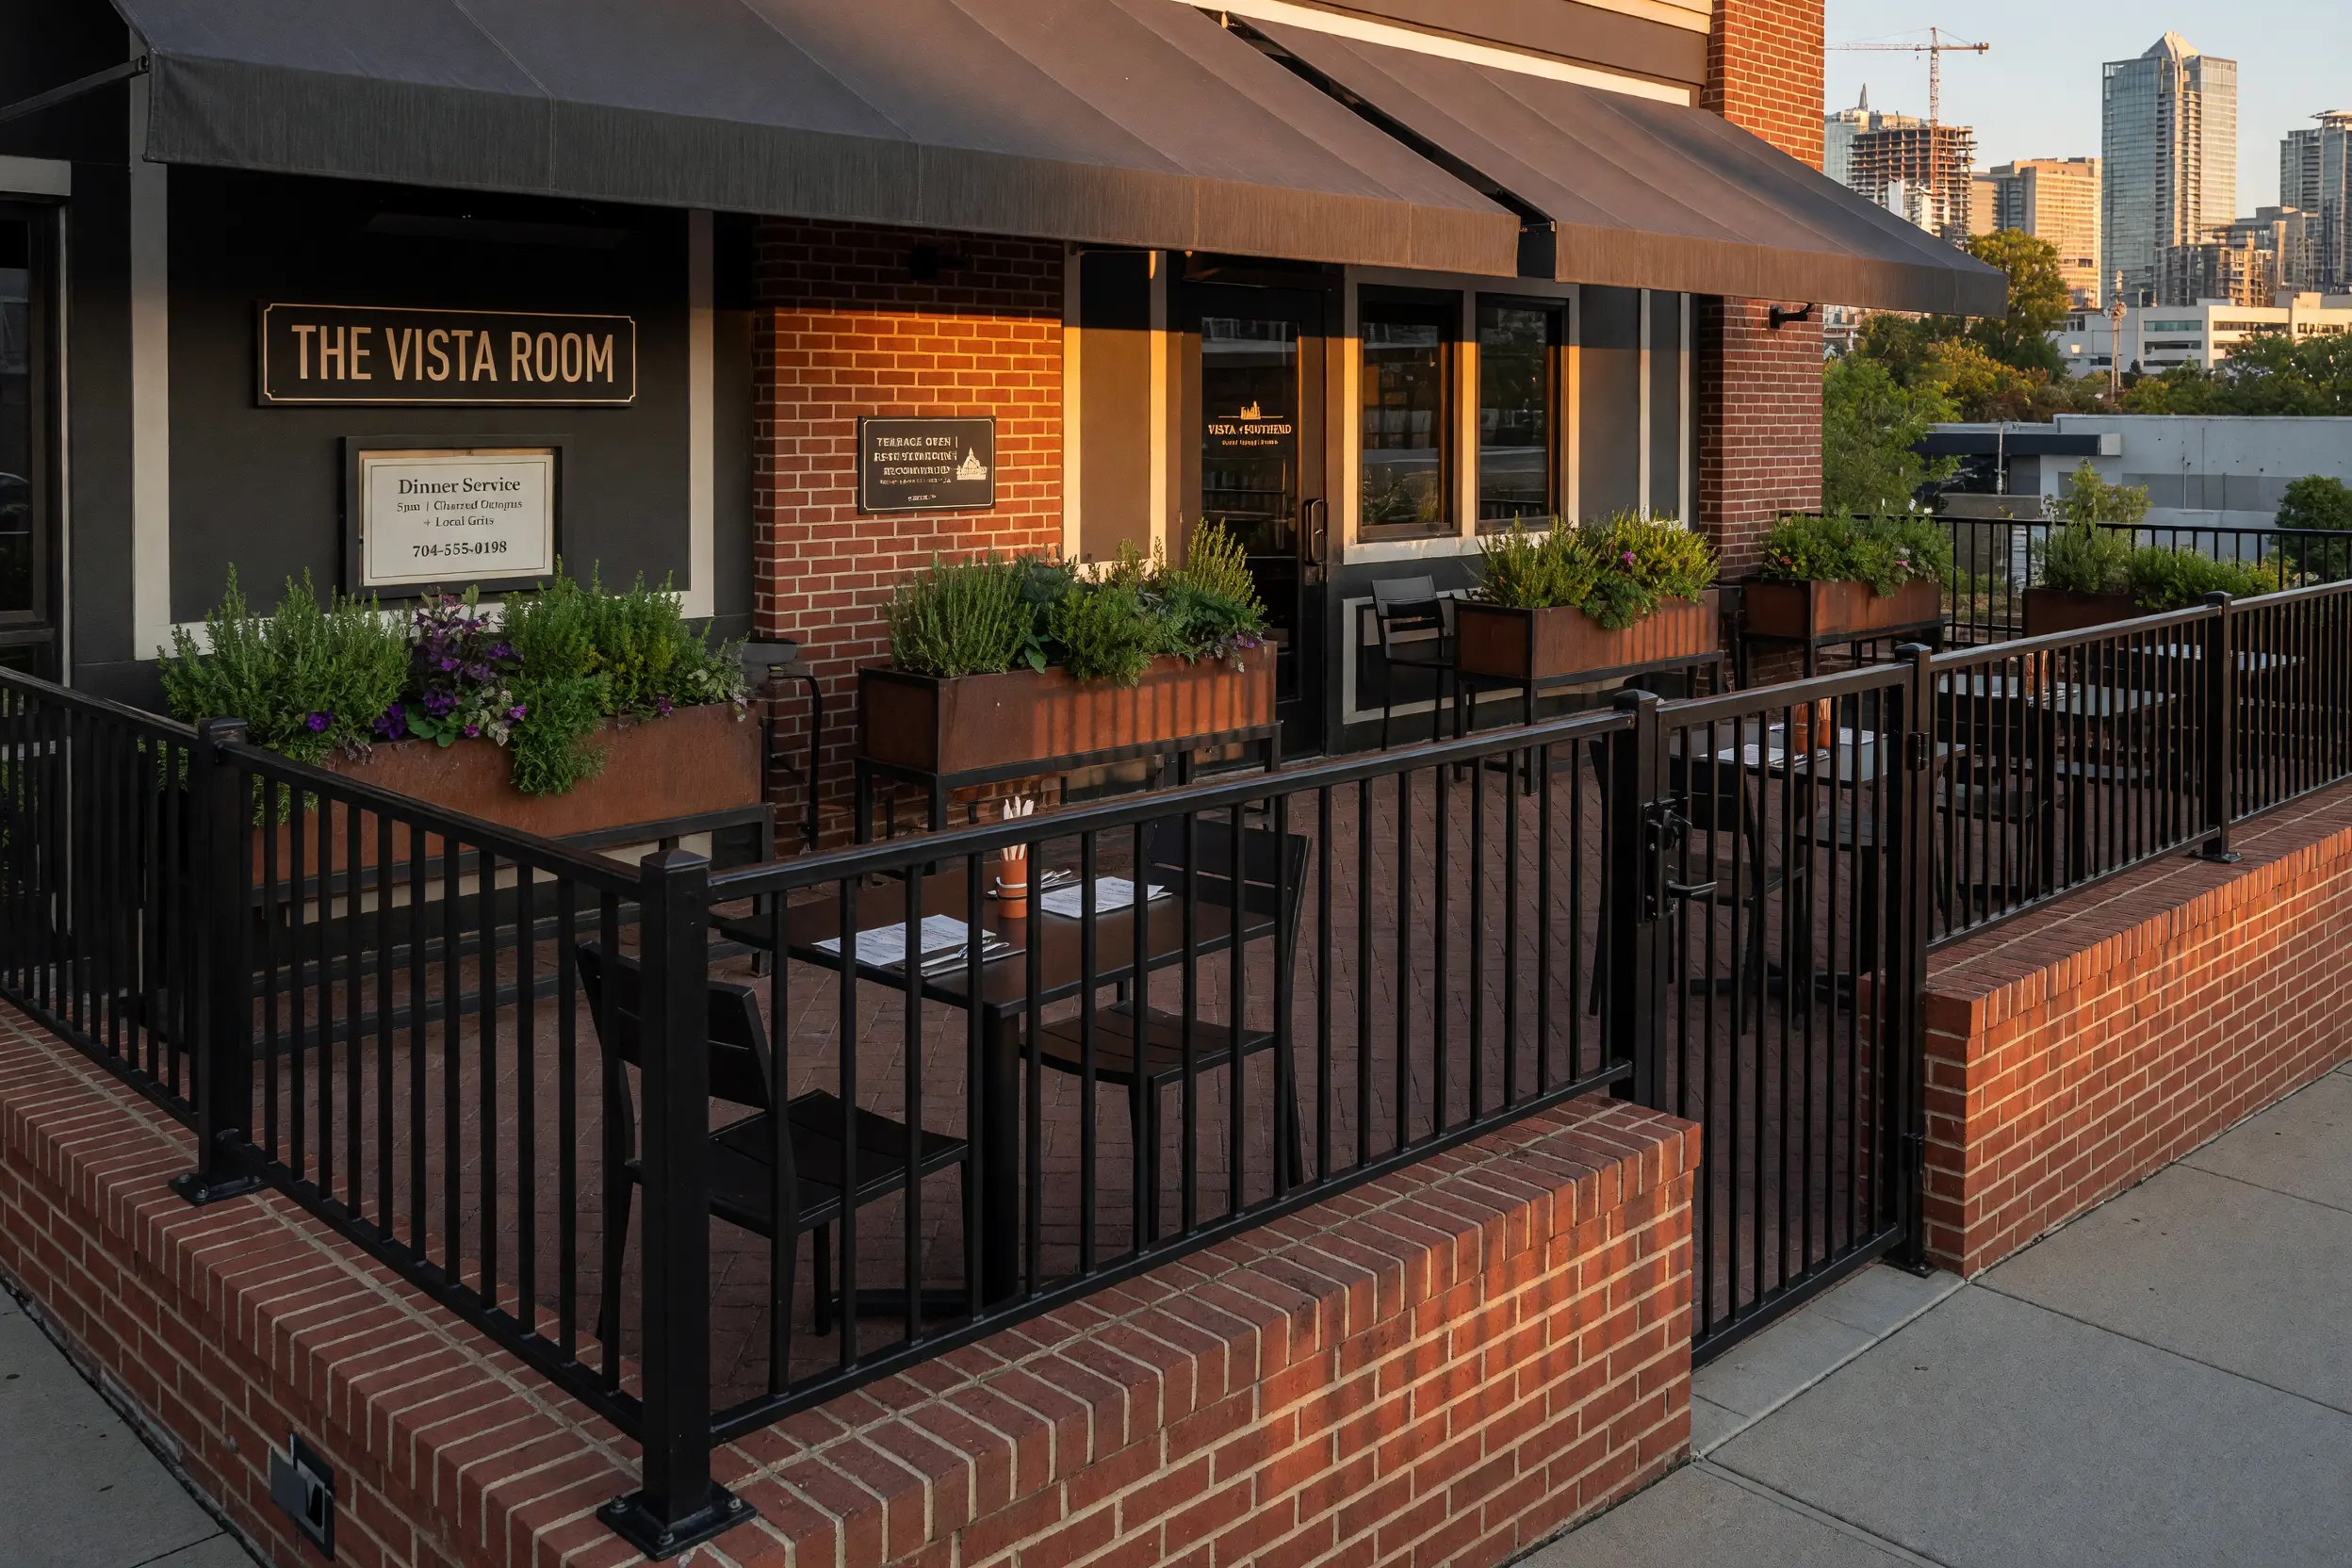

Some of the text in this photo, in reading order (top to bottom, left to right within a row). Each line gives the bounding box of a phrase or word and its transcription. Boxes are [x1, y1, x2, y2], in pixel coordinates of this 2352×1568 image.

[291, 325, 613, 383] THE VISTA ROOM
[1208, 424, 1236, 434] VISTA
[876, 437, 923, 447] TERRACE
[398, 476, 521, 495] Dinner Service
[435, 515, 465, 527] Local
[467, 515, 495, 526] Grits
[413, 540, 508, 558] 704-555-0198
